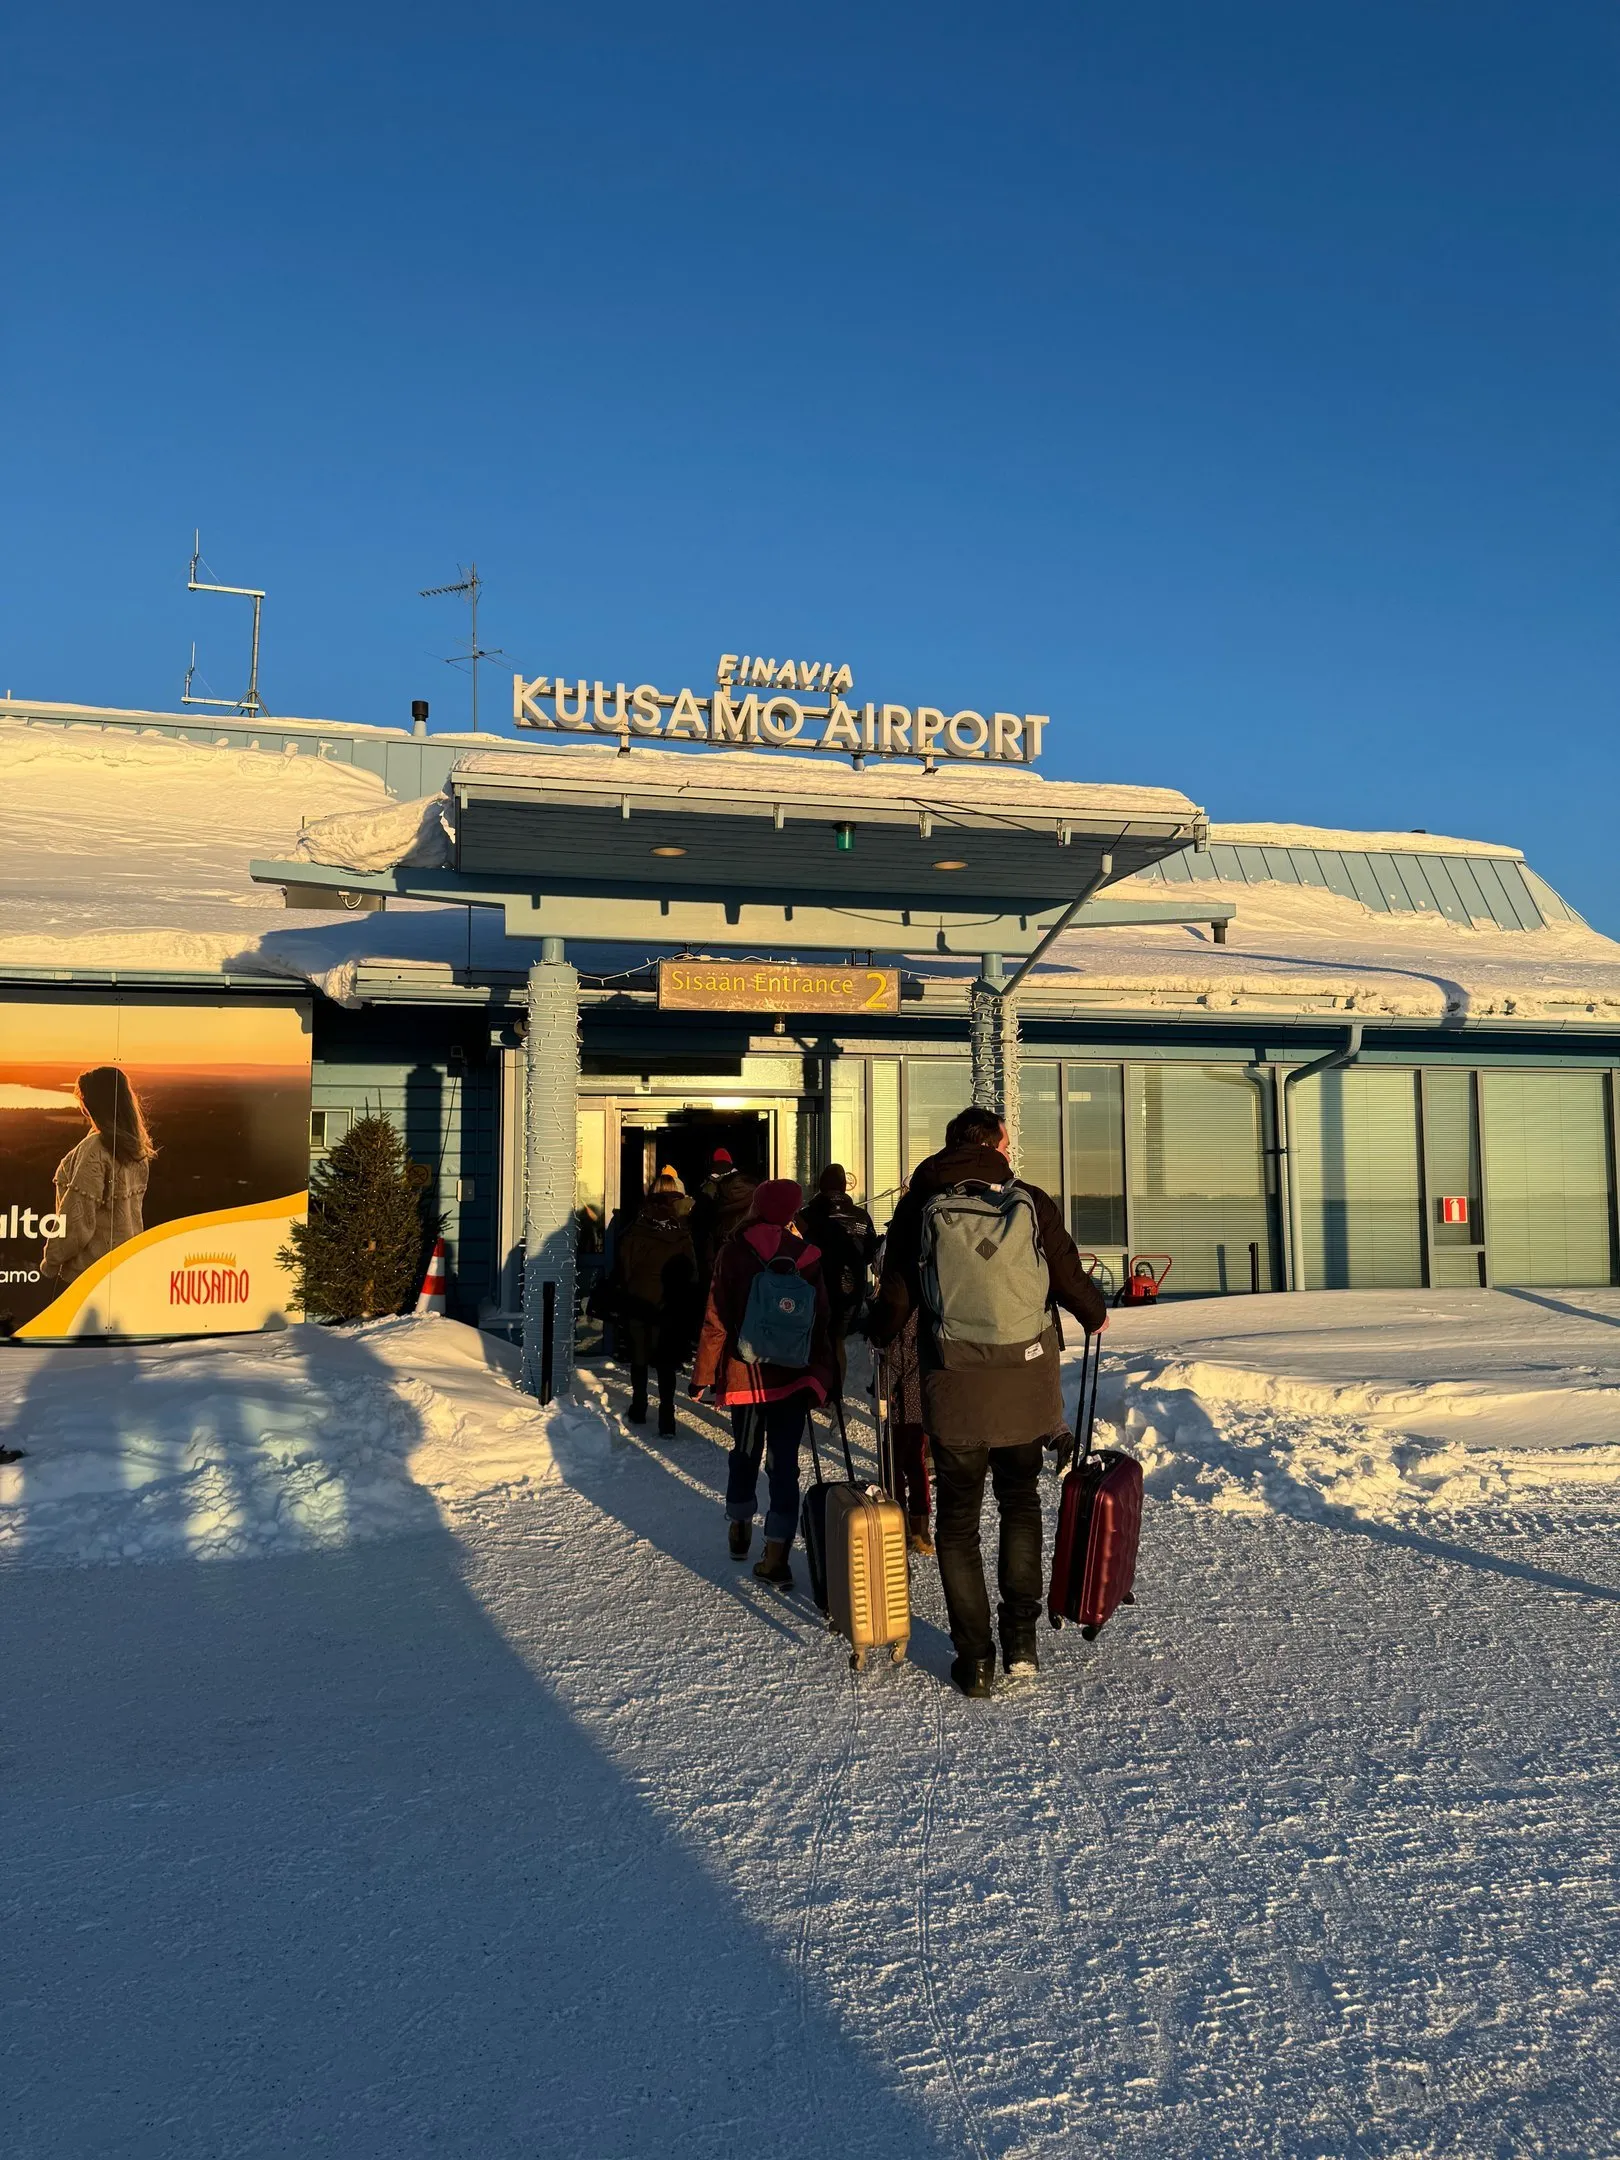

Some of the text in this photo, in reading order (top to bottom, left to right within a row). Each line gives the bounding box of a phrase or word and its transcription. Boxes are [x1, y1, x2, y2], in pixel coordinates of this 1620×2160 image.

[717, 653, 854, 690] FINAVIA
[512, 674, 1050, 760] KUUSAMO AIRPORT
[672, 971, 888, 1008] Sisään Entrance 2
[0, 1204, 67, 1239] lta
[169, 1269, 249, 1305] KUUSAMO
